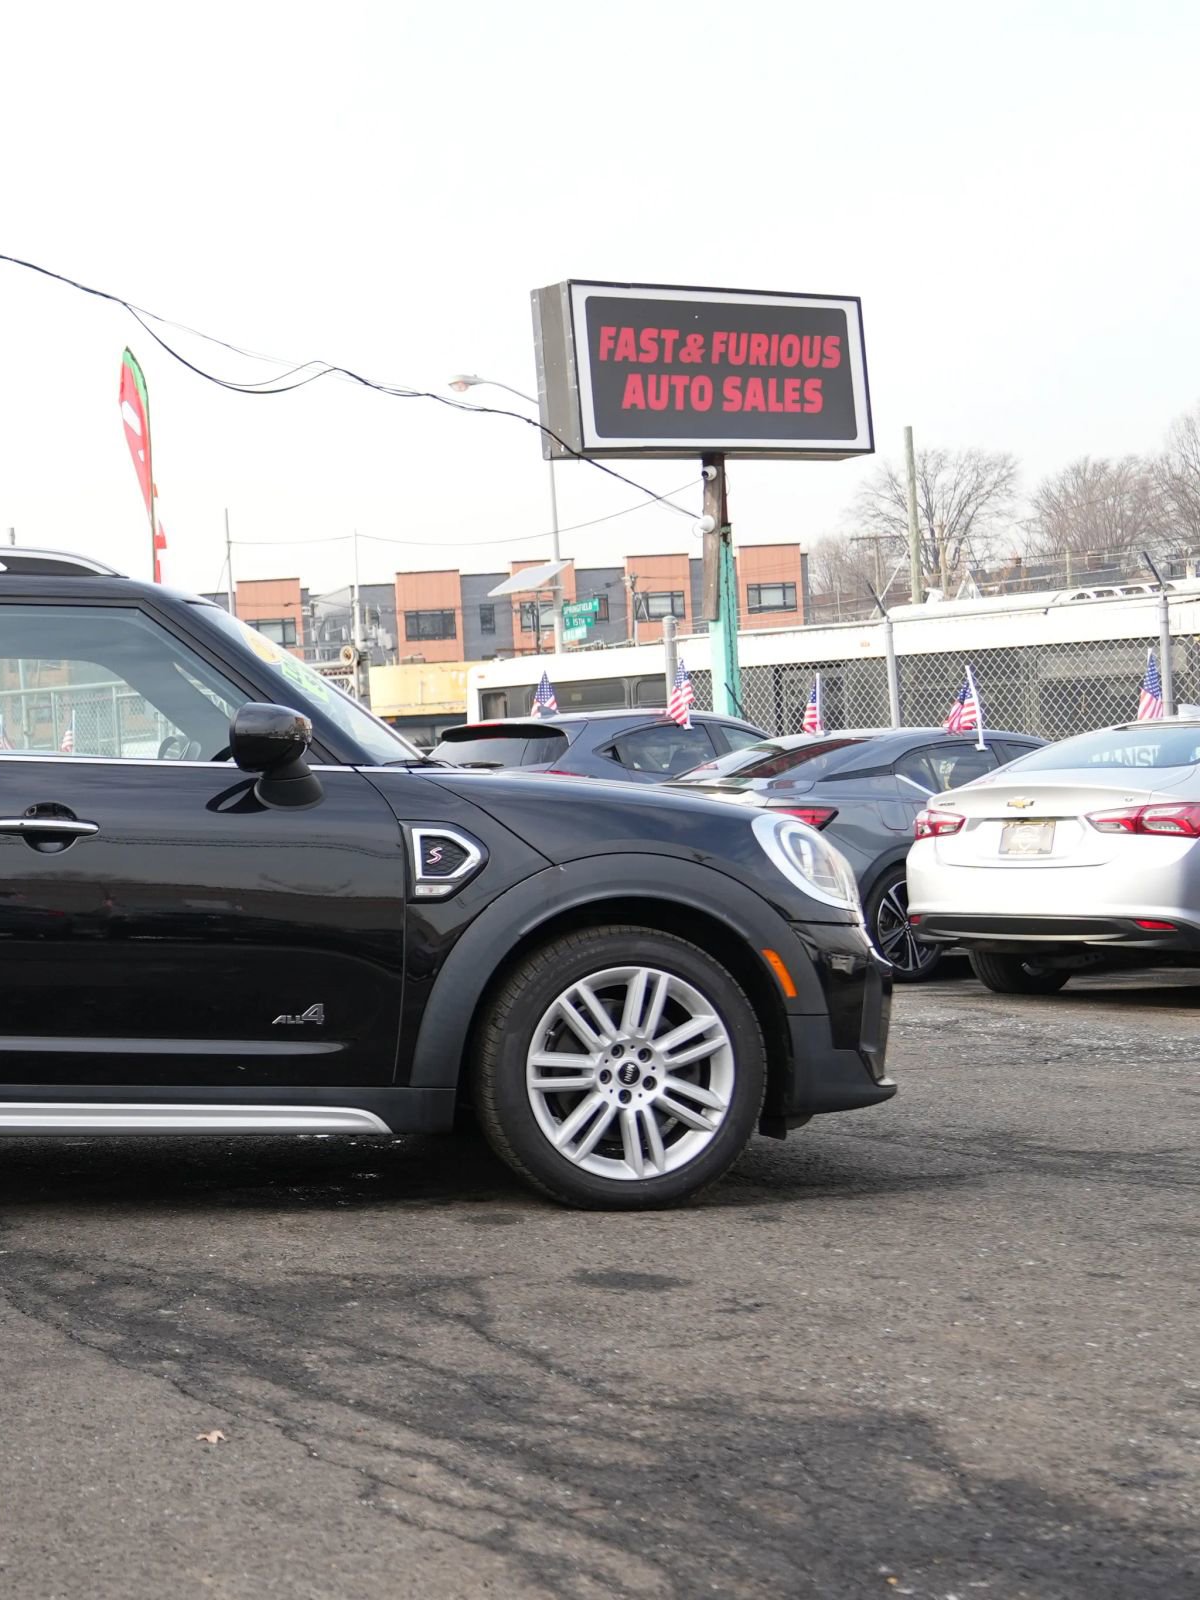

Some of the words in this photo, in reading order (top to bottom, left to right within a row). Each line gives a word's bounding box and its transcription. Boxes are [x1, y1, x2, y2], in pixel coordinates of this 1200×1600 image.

[711, 331, 842, 369] FURIOUS
[621, 373, 714, 412] AUTO
[722, 376, 824, 414] SALES
[426, 847, 443, 865] S
[623, 1063, 636, 1082] MINI
